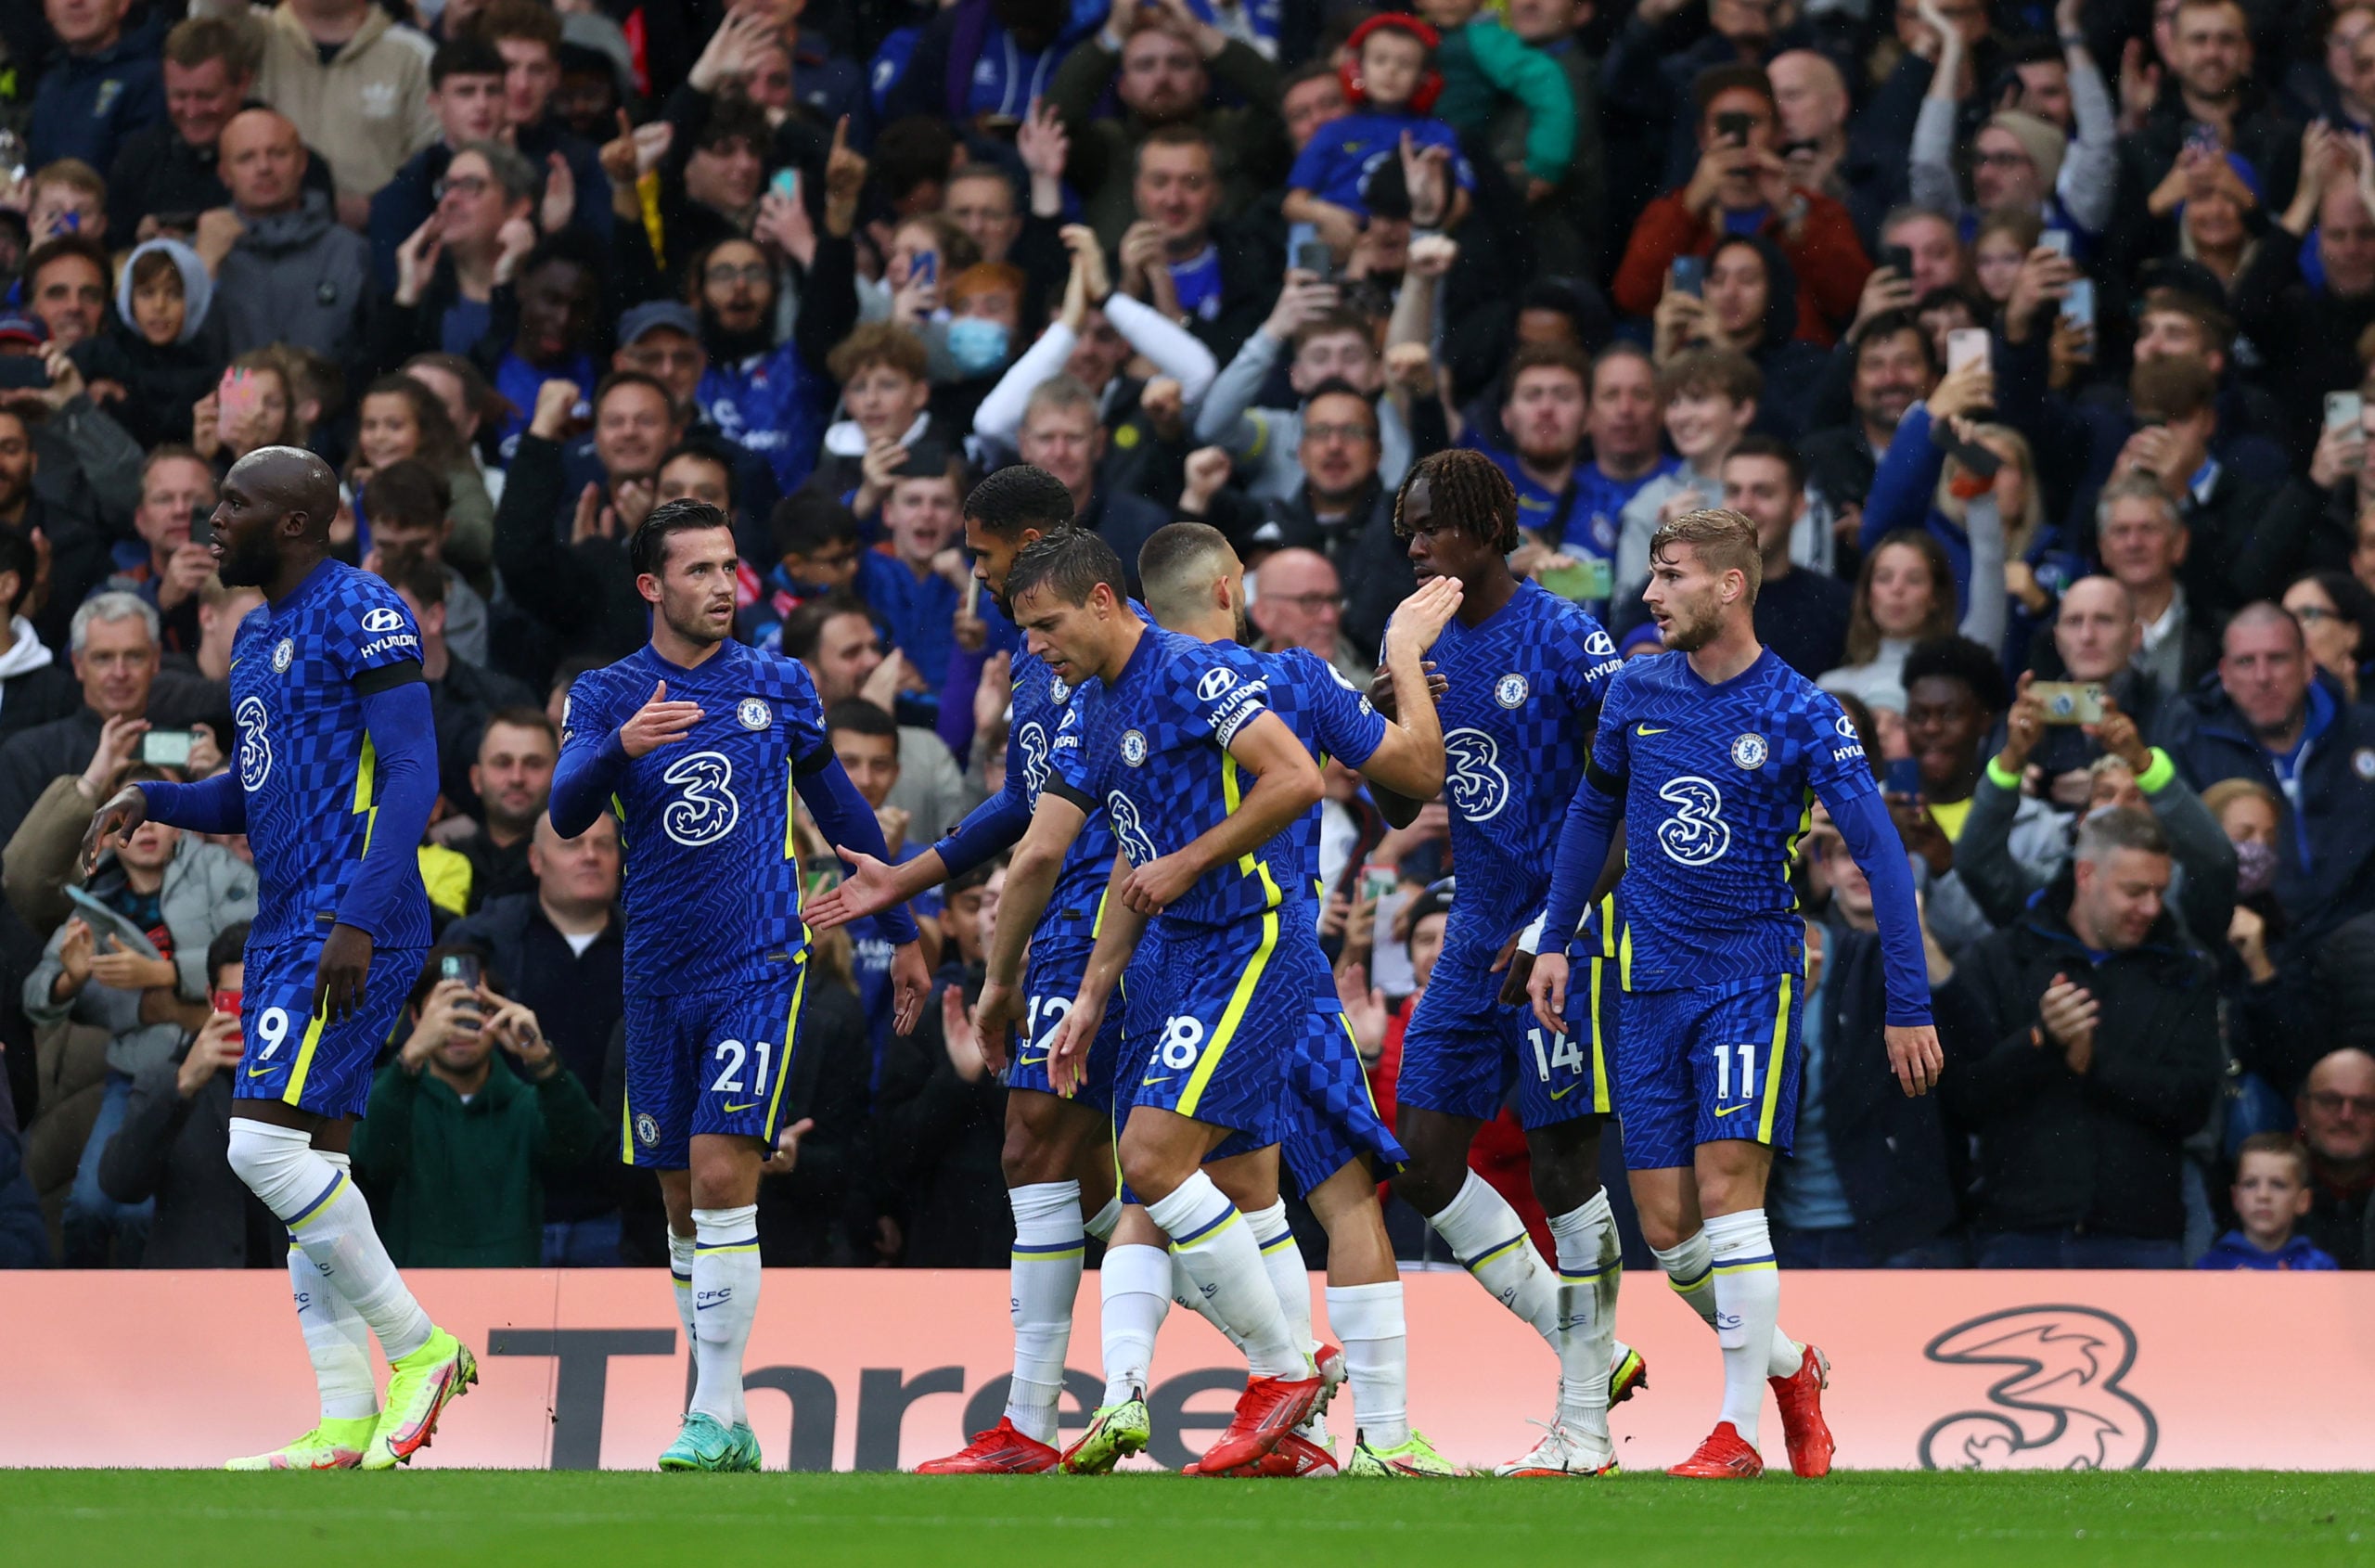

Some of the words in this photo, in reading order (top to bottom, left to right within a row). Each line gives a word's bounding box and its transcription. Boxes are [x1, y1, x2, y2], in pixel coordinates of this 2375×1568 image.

[236, 696, 273, 791] 3
[1218, 705, 1249, 744] aptain
[663, 751, 739, 847] 3
[1444, 727, 1509, 822] 3
[1657, 776, 1731, 867] 3
[258, 1006, 289, 1060] 9
[1527, 1022, 1584, 1083] 14
[711, 1039, 771, 1097] 21
[1714, 1045, 1755, 1099] 11
[697, 1288, 732, 1300] CFC
[487, 1328, 1252, 1472] Three
